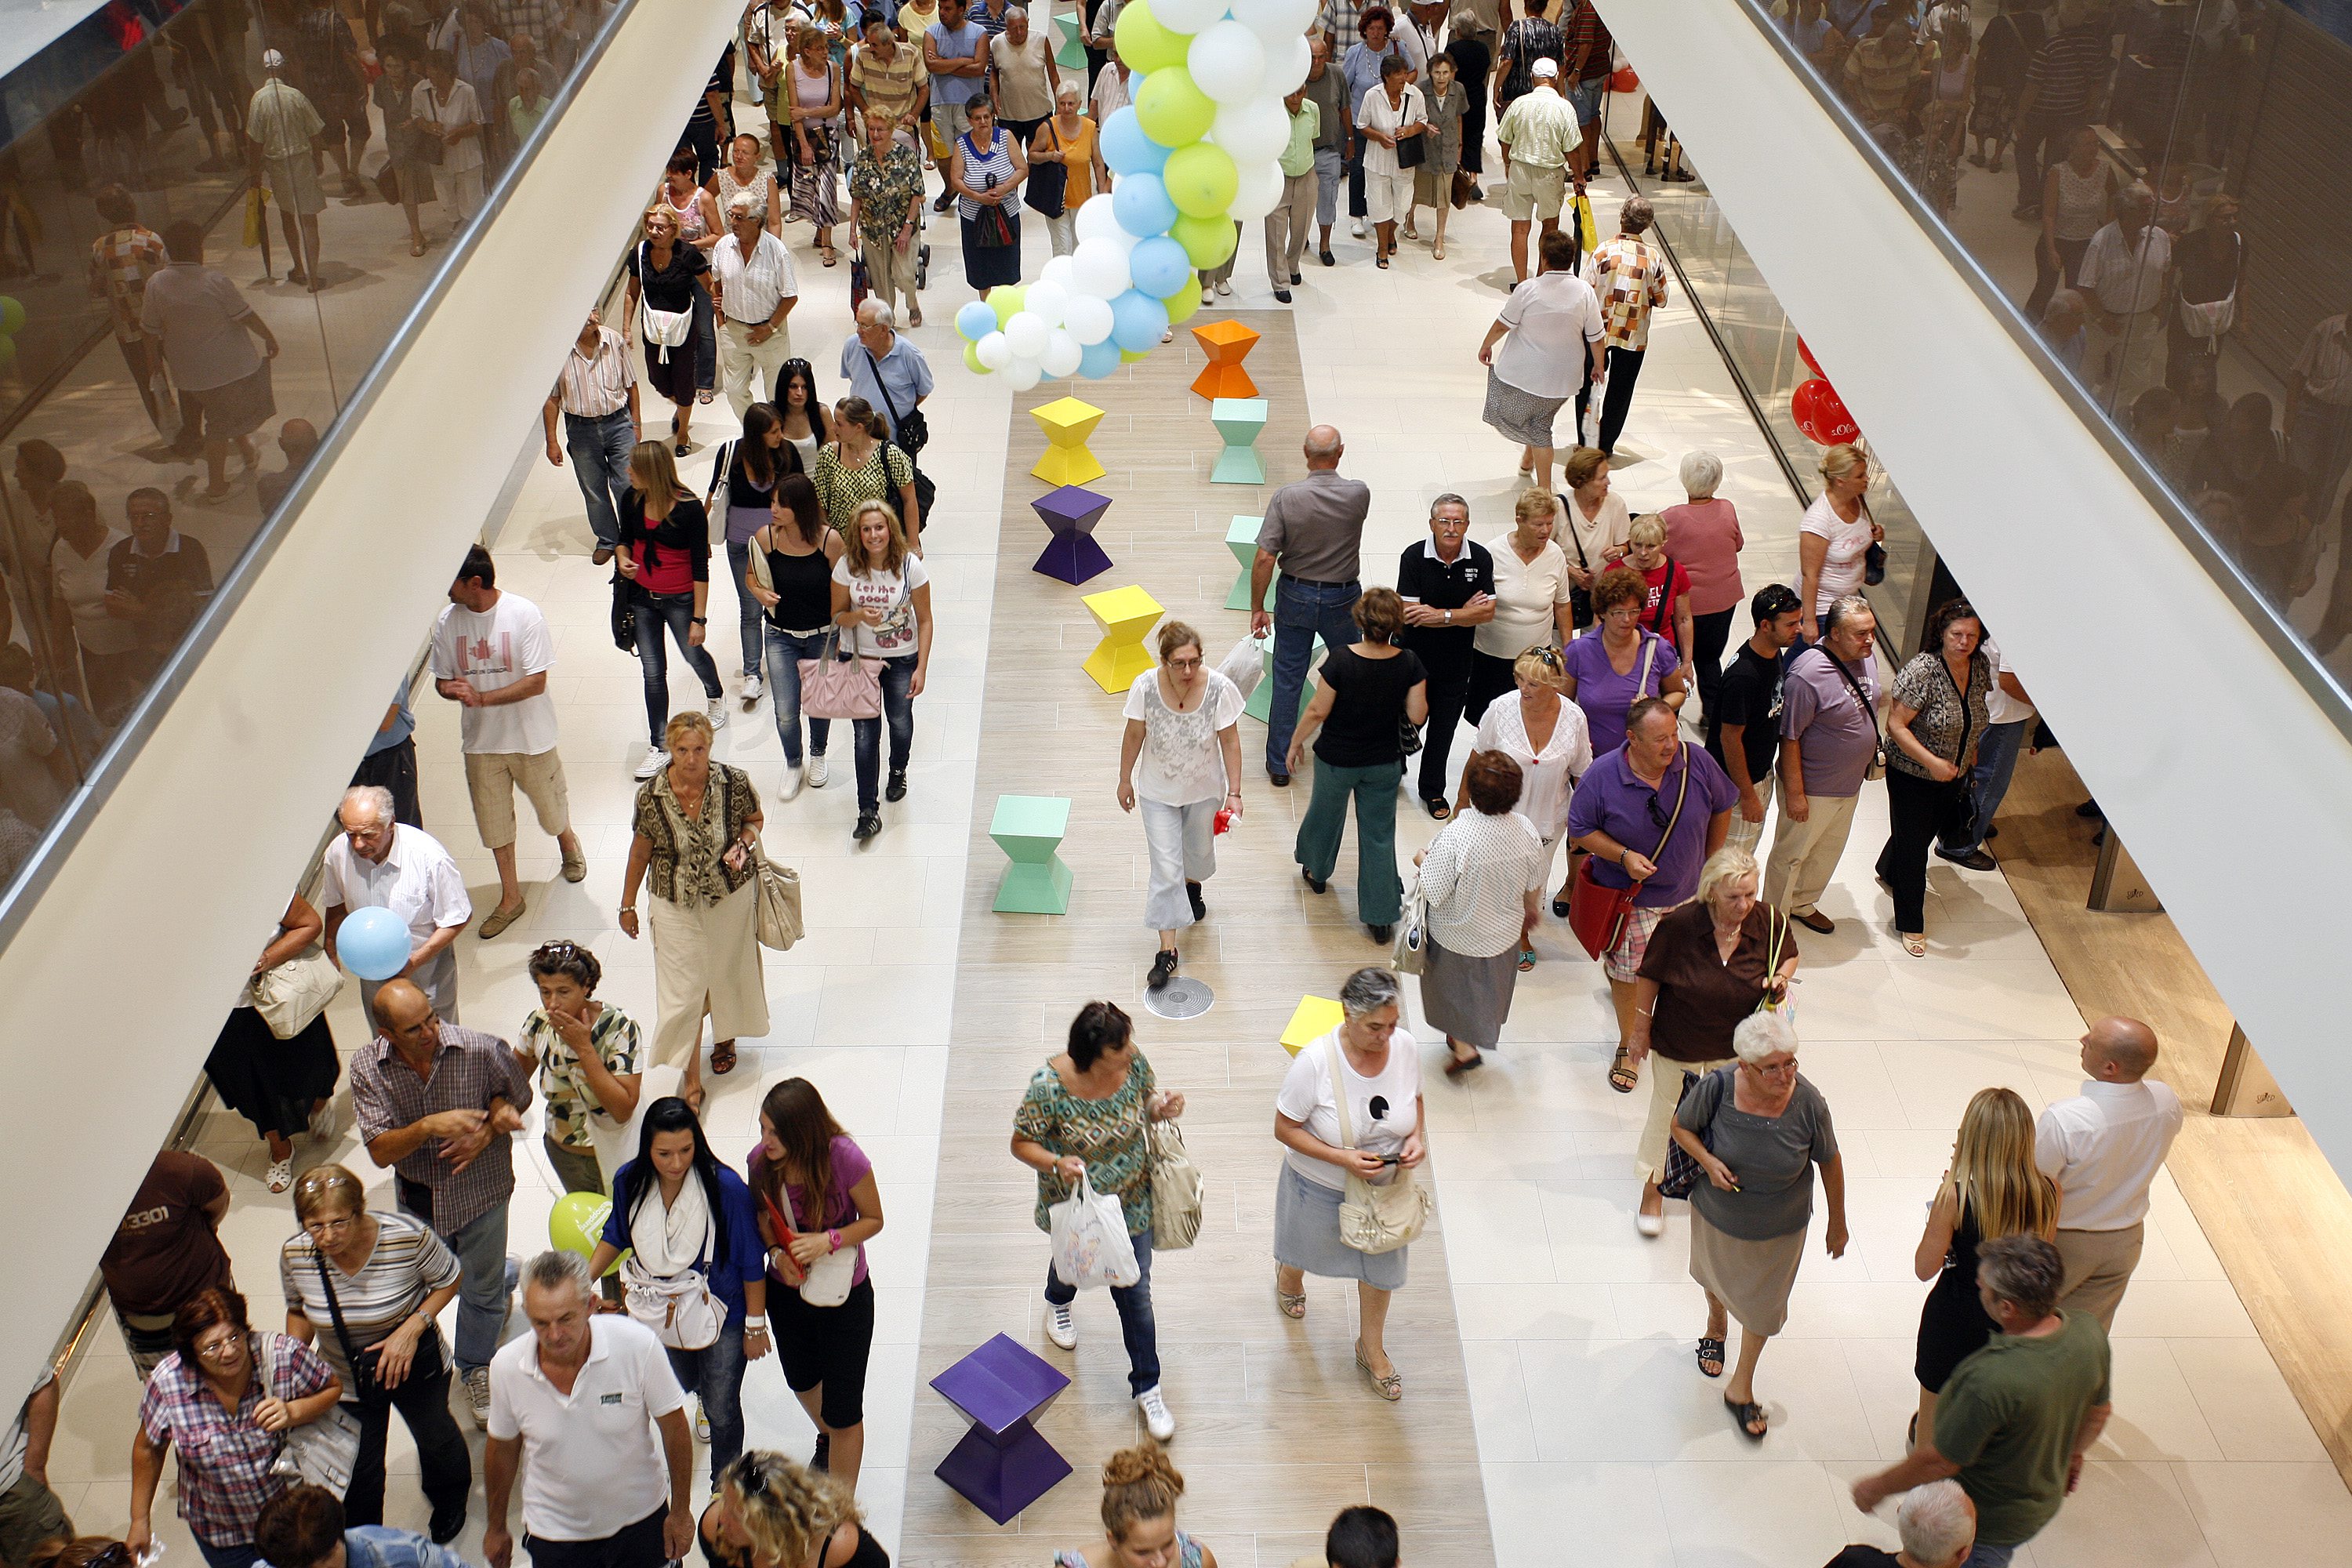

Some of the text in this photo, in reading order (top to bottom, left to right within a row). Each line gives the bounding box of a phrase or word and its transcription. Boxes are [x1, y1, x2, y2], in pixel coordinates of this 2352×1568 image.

[856, 583, 896, 593] Let the
[858, 594, 889, 605] good
[126, 1206, 169, 1229] 3301
